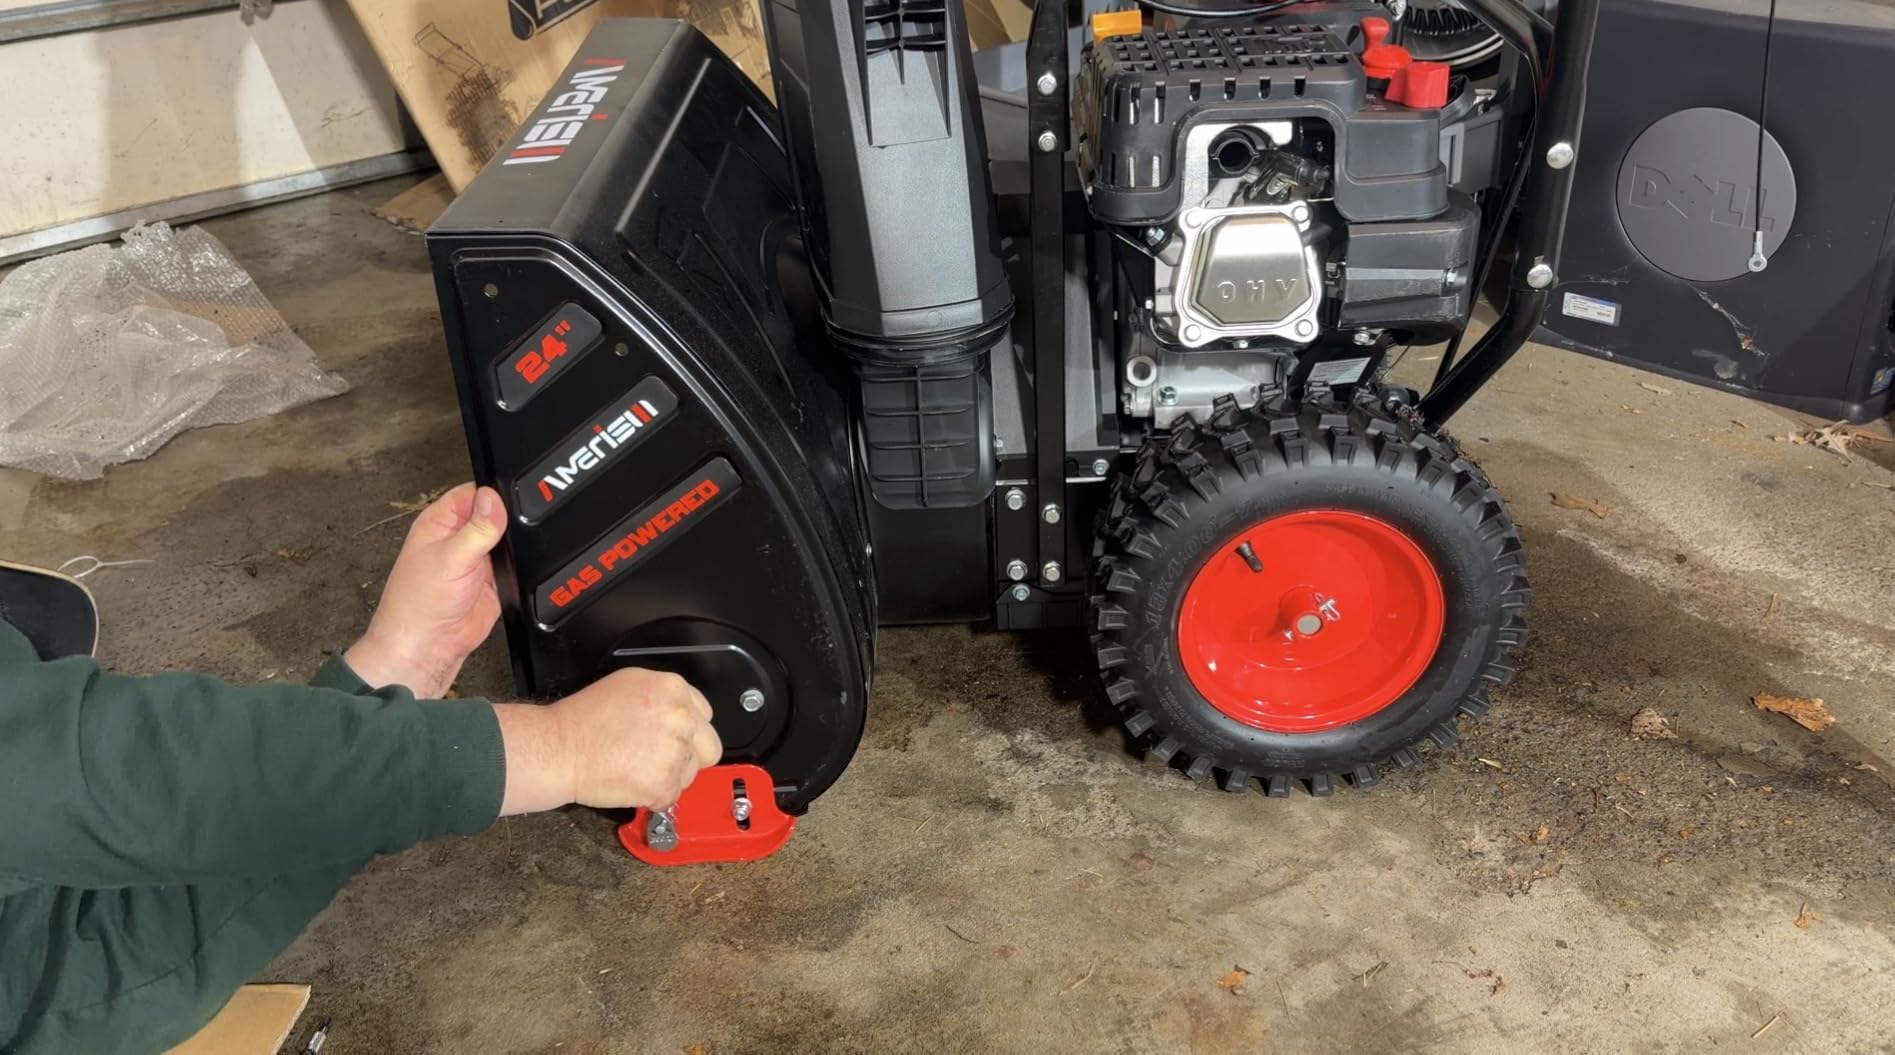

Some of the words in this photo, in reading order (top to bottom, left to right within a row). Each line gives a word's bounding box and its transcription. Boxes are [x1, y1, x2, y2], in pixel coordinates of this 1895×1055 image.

[1629, 164, 1775, 232] DELL
[1217, 278, 1297, 303] OHV
[514, 320, 571, 384] 24"
[549, 565, 602, 607] GAS
[598, 479, 720, 571] POWERED
